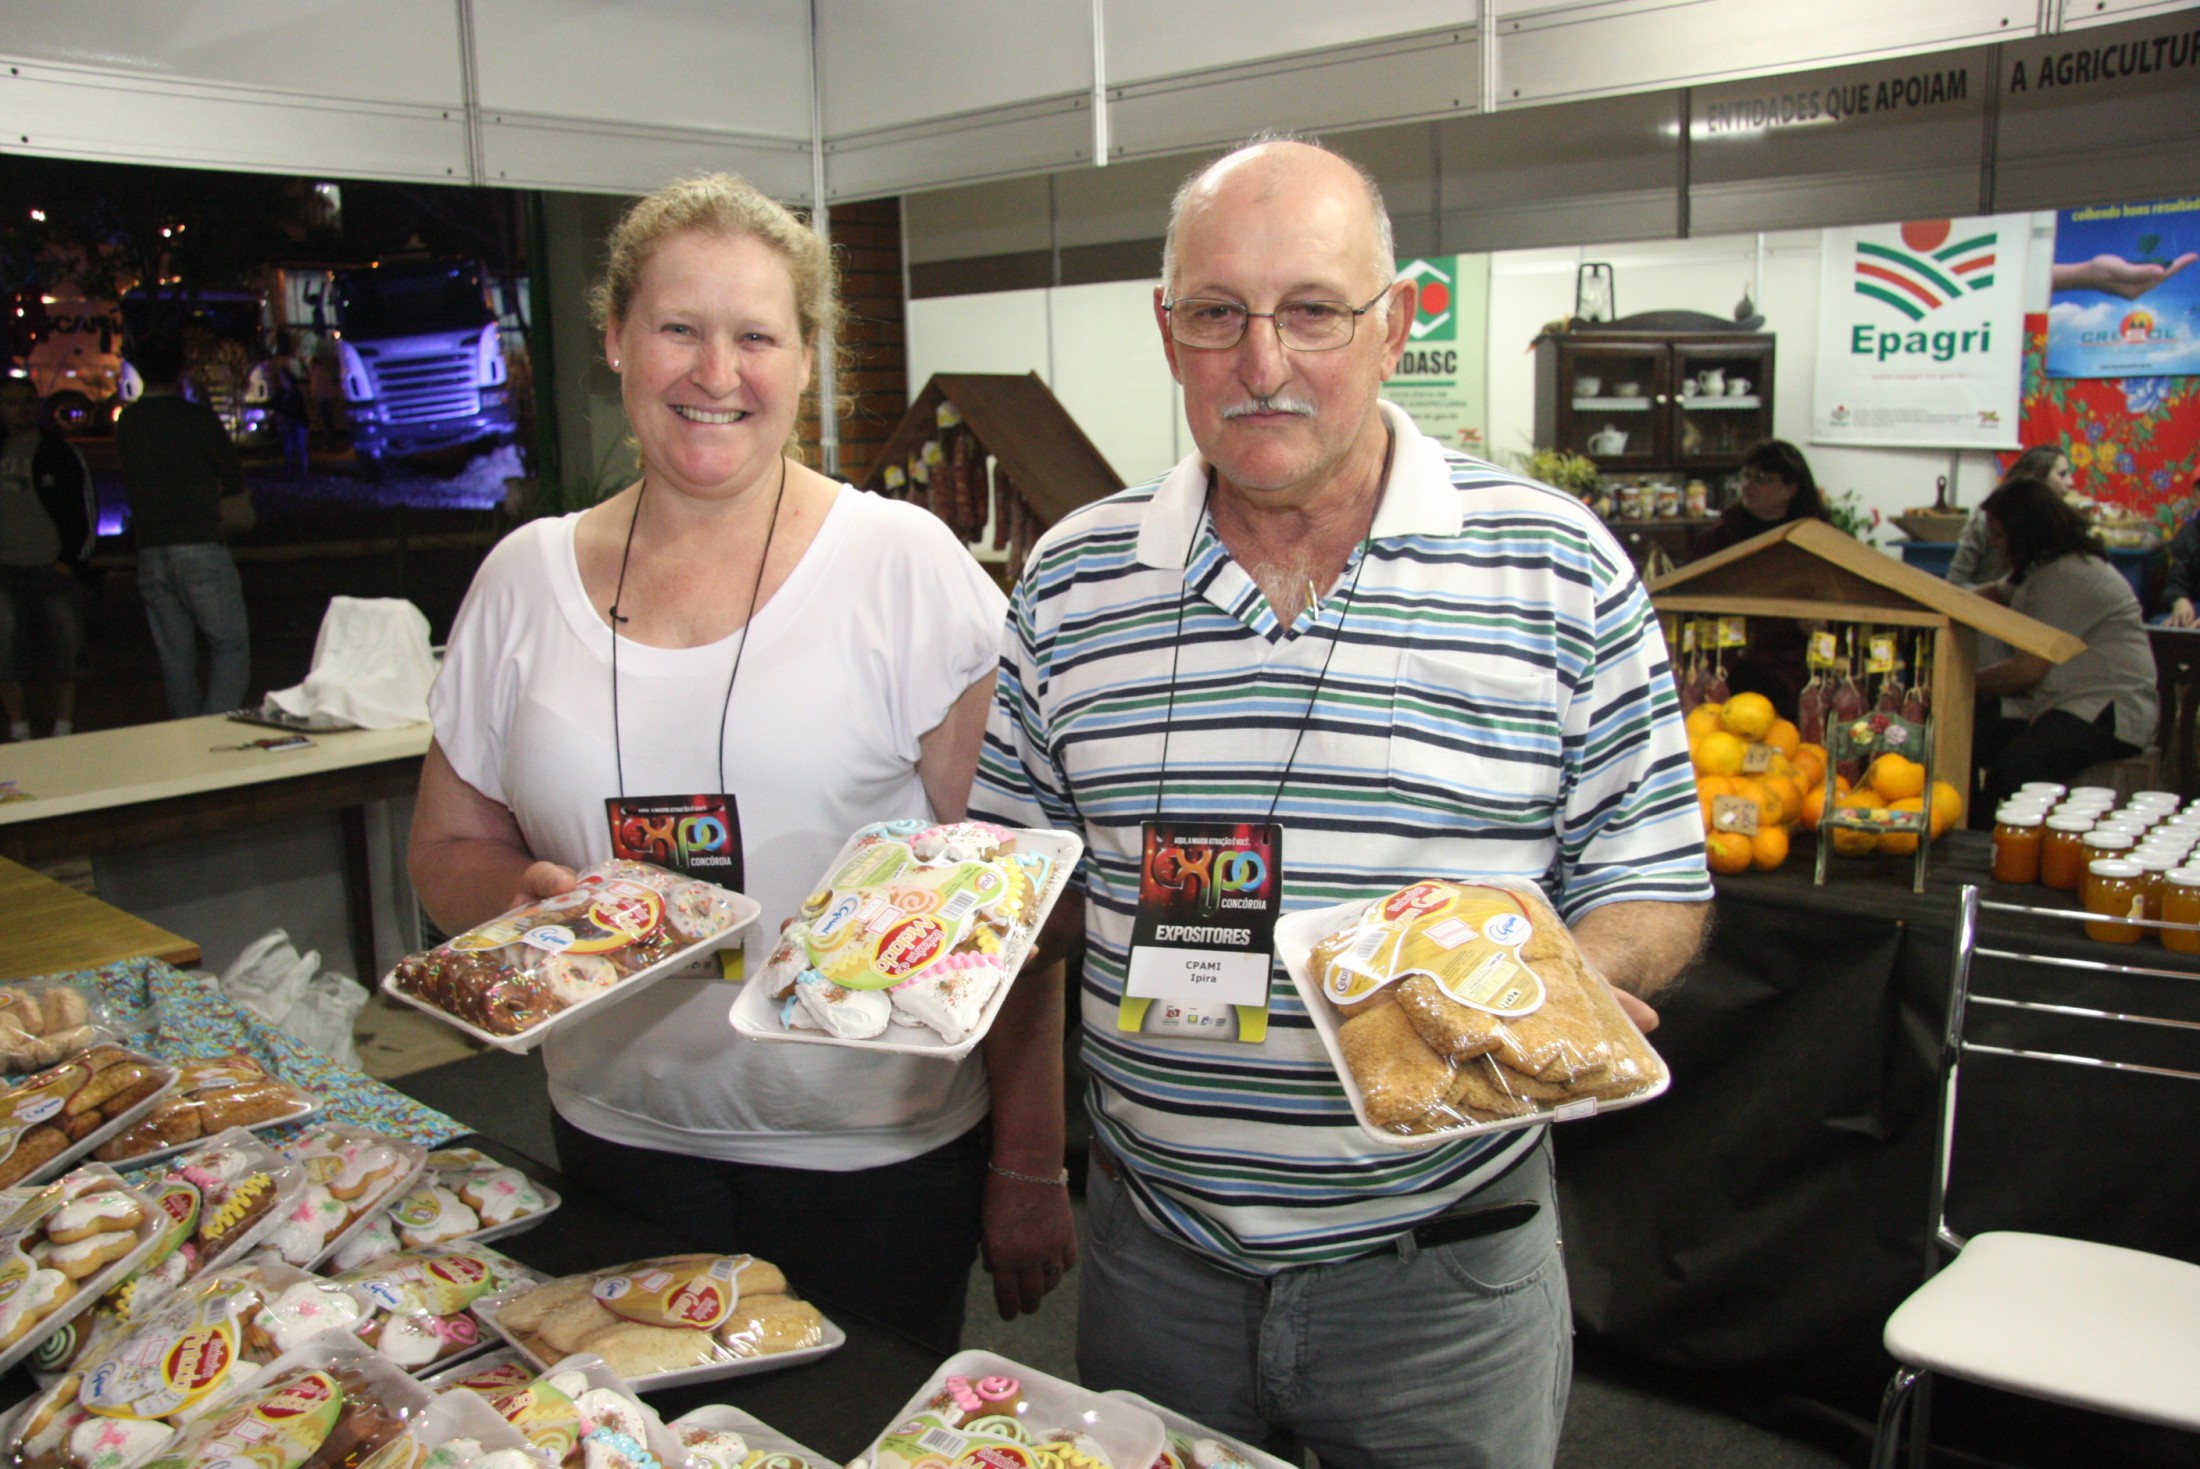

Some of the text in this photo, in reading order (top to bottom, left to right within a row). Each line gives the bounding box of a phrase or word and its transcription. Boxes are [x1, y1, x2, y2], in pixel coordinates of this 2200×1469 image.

[1707, 90, 1821, 133] ENTIDADES
[1826, 84, 1871, 120] QUE
[1875, 69, 1968, 112] APOIAM
[2010, 60, 2027, 93] A
[1851, 321, 1992, 362] Epagri
[1394, 350, 1458, 375] IDASC
[690, 855, 732, 867] CONCÓRDIA
[1221, 897, 1267, 910] CONCÓRDIA
[875, 914, 936, 972] Melado
[1155, 924, 1251, 946] EXPOSITORES
[1185, 960, 1222, 971] CPAMI
[1190, 973, 1217, 984] Ipira
